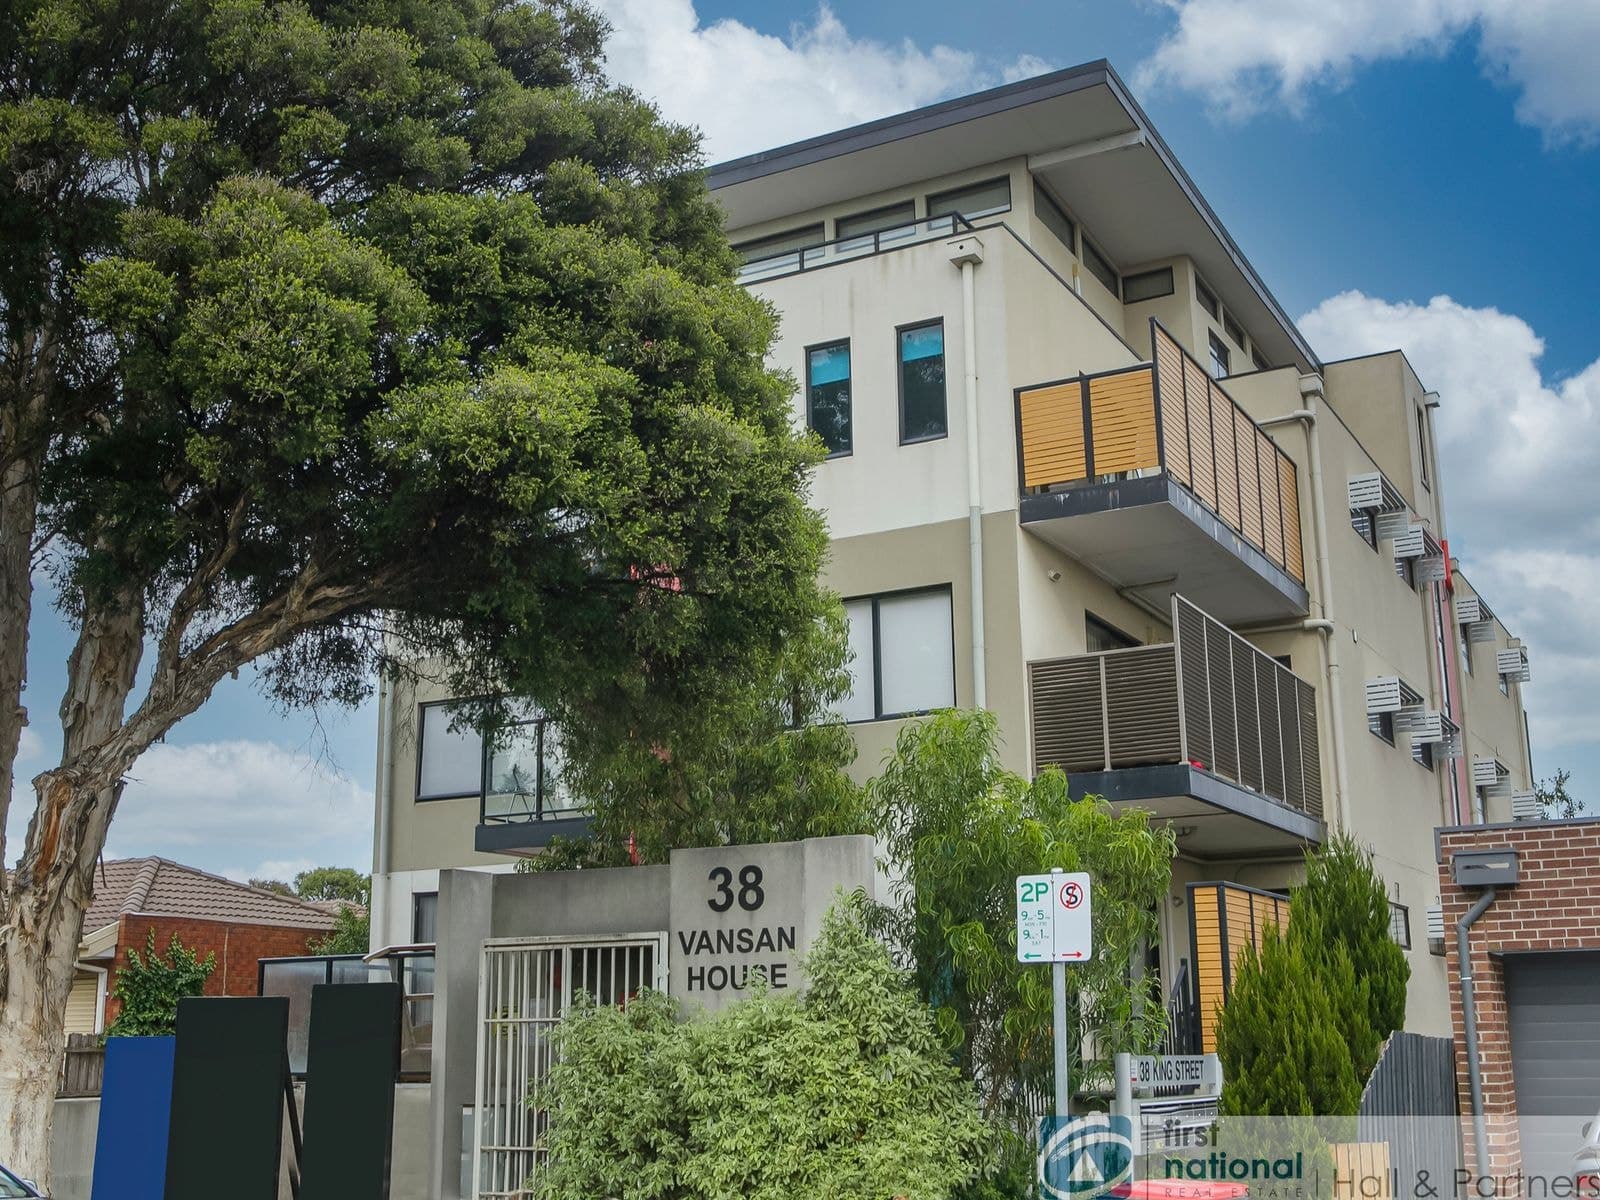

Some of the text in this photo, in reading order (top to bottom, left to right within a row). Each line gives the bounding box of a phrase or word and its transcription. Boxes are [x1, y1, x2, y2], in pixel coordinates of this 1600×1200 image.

[707, 865, 765, 913] 38
[1021, 882, 1048, 902] 2P
[678, 926, 796, 956] VANSAN
[687, 963, 788, 991] HOUSE
[1139, 1061, 1150, 1082] 38
[1175, 1060, 1204, 1081] STREET
